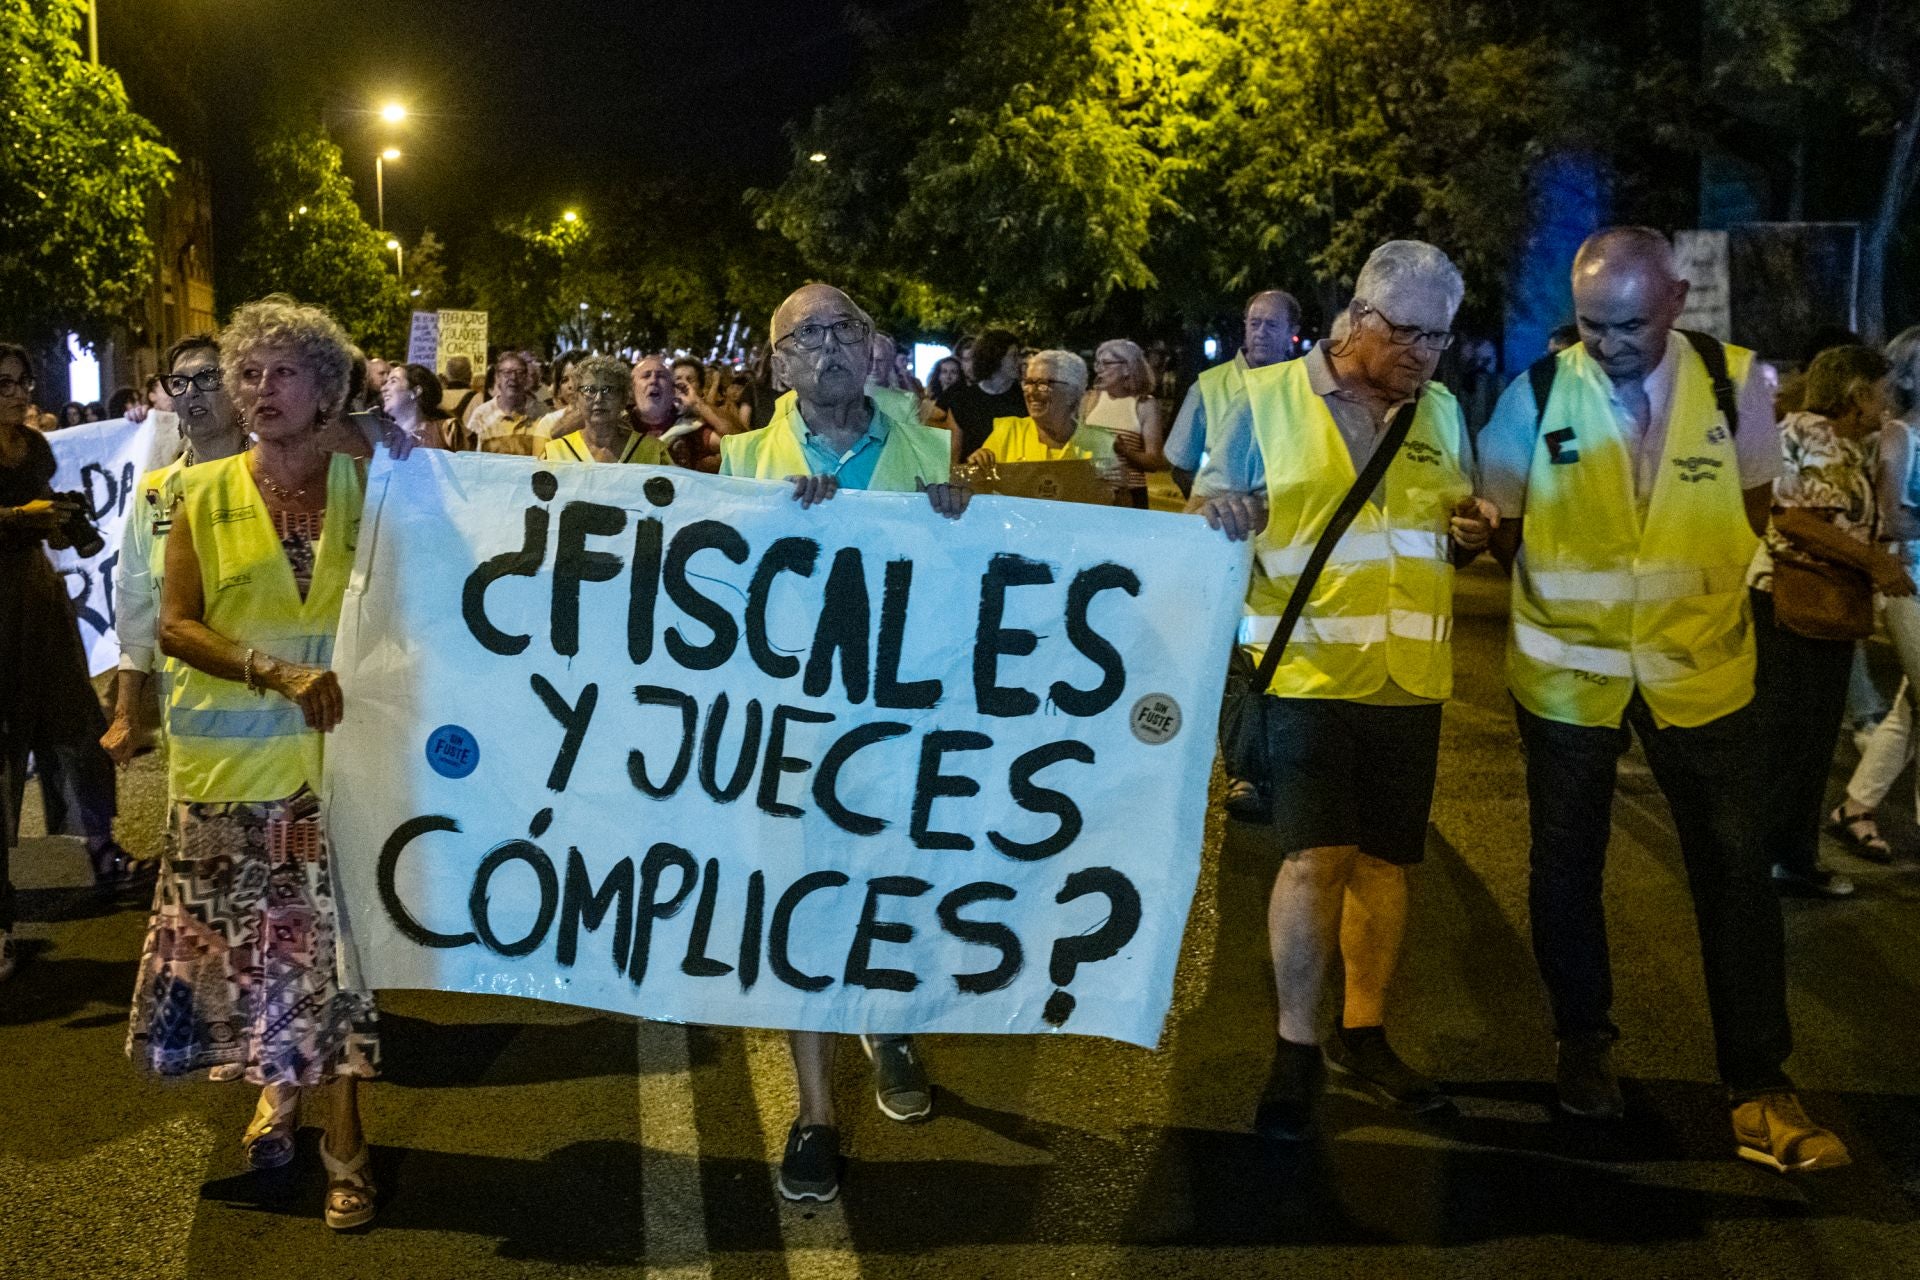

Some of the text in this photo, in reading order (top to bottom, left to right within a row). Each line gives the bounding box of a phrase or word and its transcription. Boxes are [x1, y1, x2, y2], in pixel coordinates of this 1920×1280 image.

[462, 471, 1142, 717] ¿FISCALES
[434, 738, 470, 764] FUSTE
[531, 674, 1096, 861] Y JUECES
[1137, 706, 1174, 732] FUSTE
[376, 807, 1142, 1027] CÓMPLICES?
